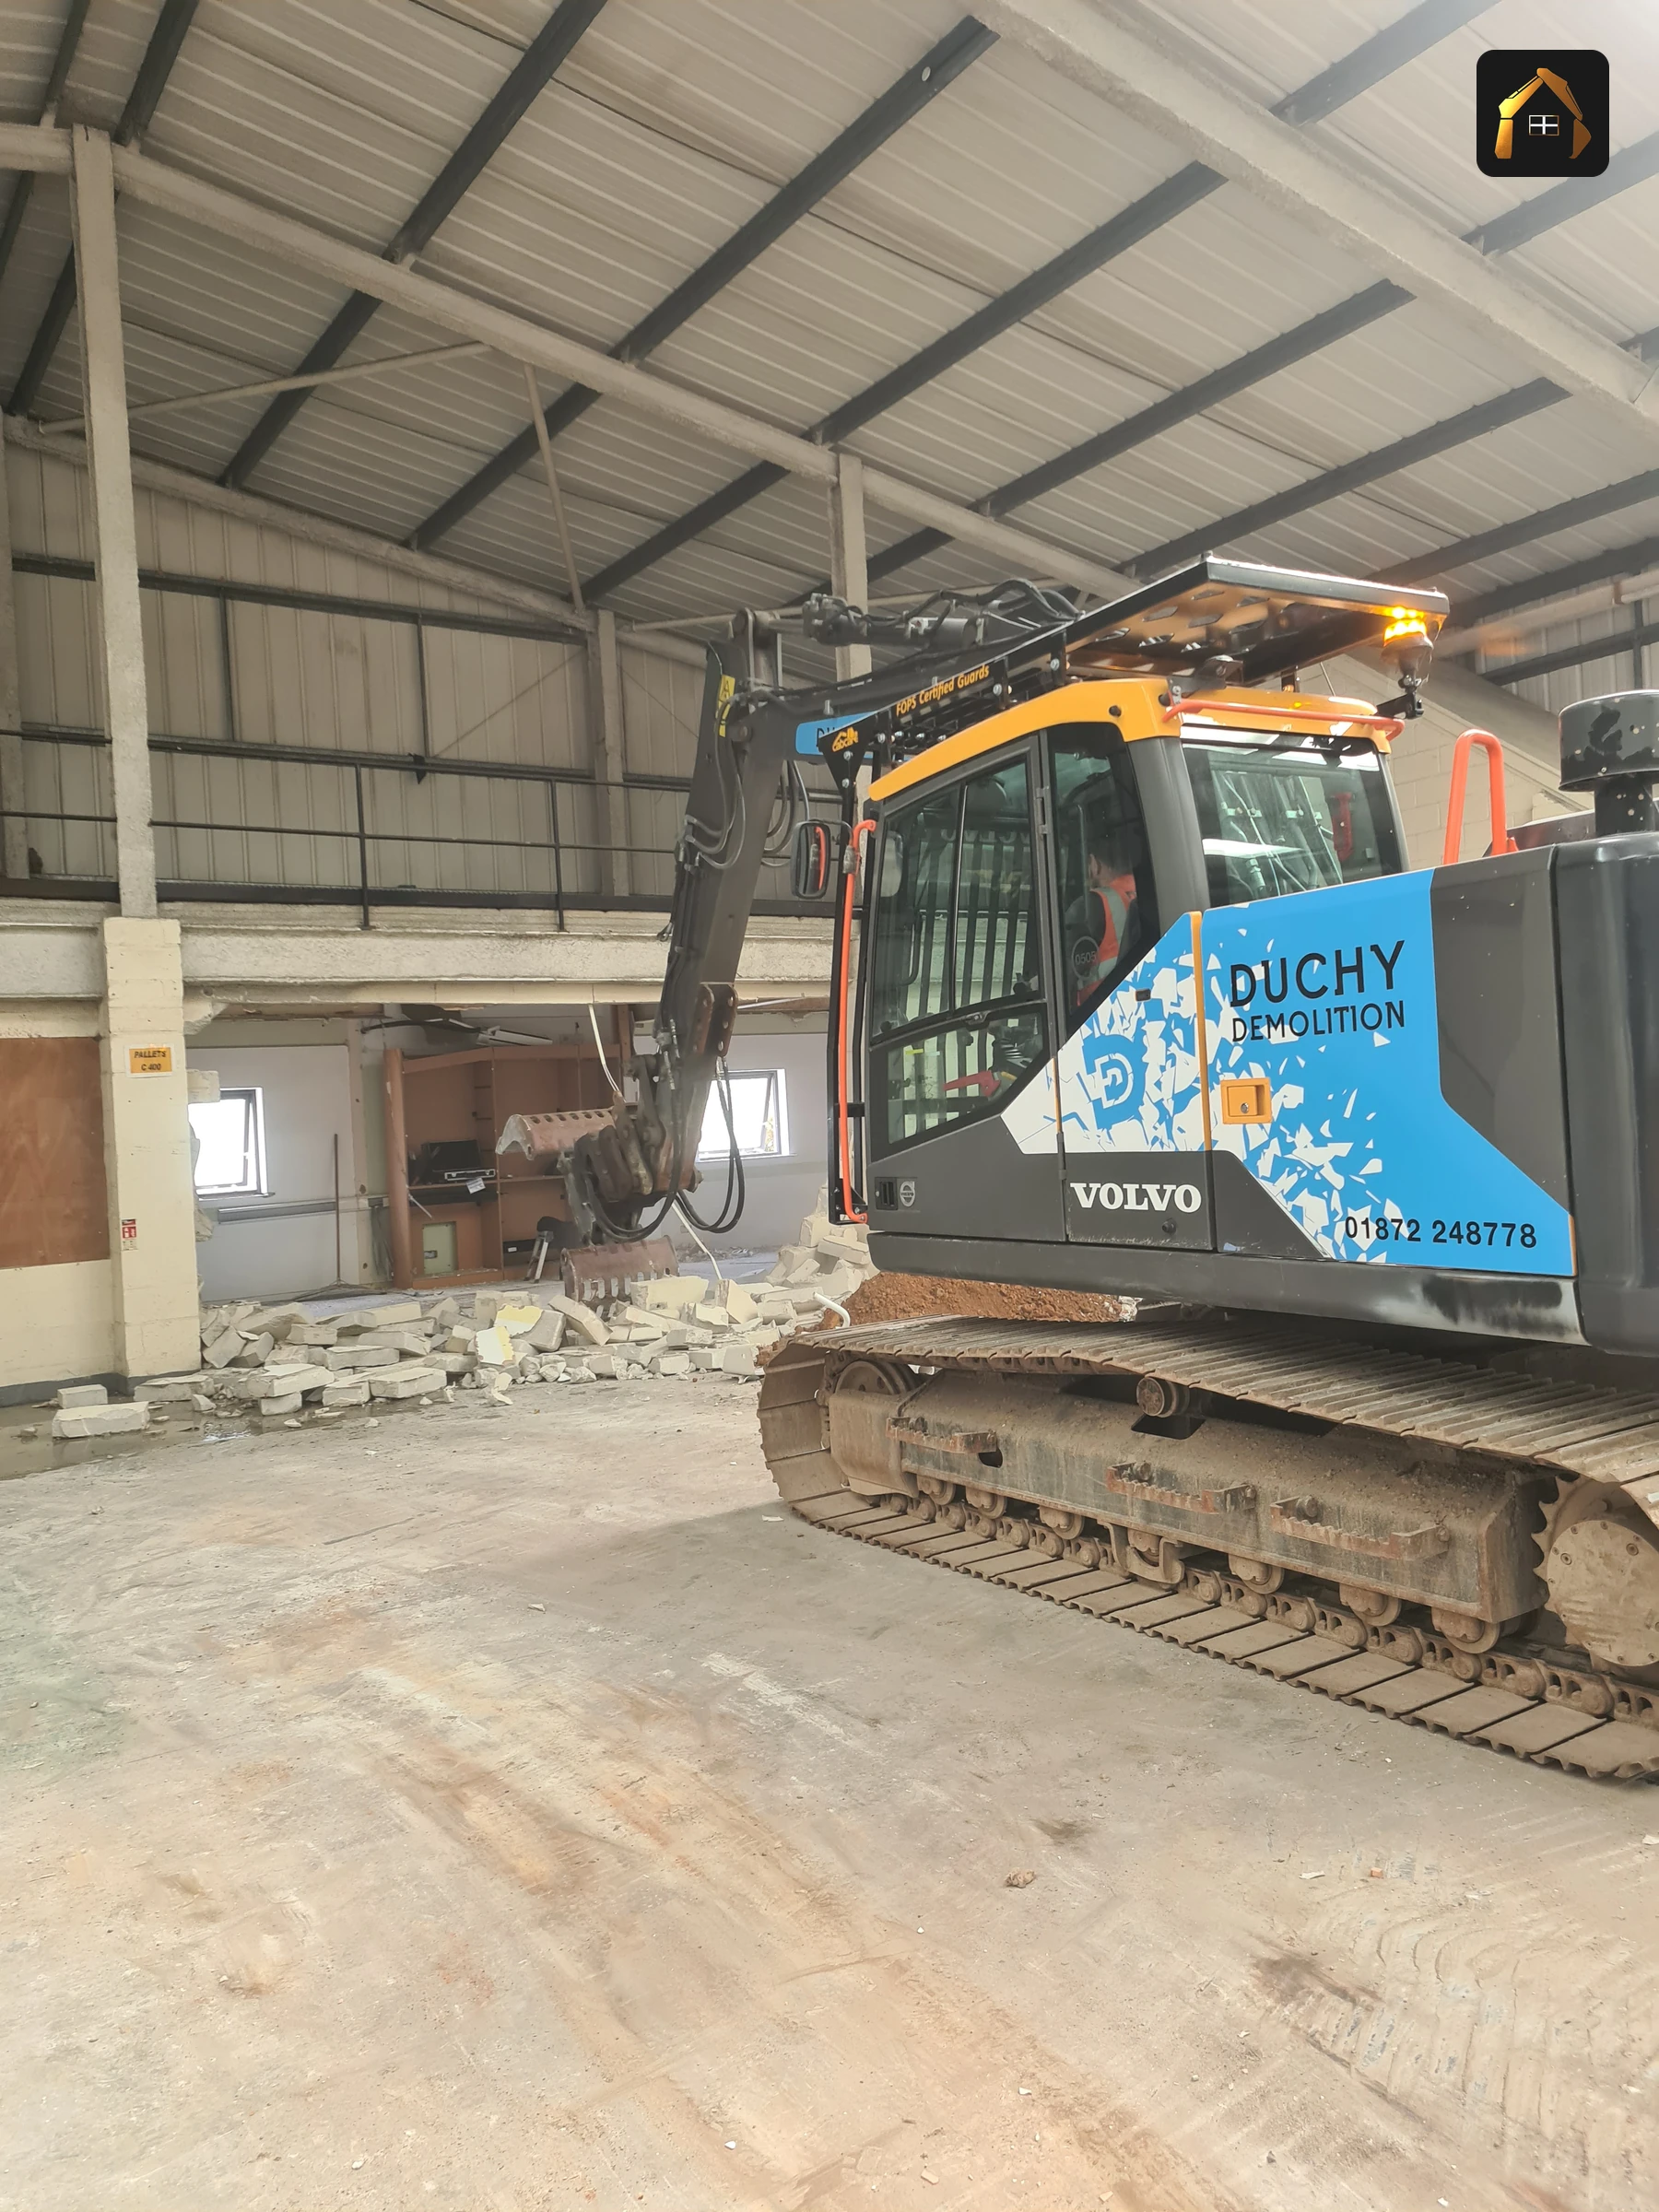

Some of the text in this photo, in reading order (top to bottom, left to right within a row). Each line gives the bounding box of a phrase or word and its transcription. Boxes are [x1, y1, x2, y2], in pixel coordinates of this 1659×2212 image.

[896, 663, 990, 717] FOPS Certified Guards
[1075, 950, 1098, 966] 0505
[1230, 939, 1406, 1007] DUCHY
[1232, 1000, 1406, 1042] DEMOLITION
[134, 1050, 167, 1058] PALLETS
[1069, 1182, 1203, 1214] VOLVO
[1344, 1216, 1538, 1249] 01872 248778
